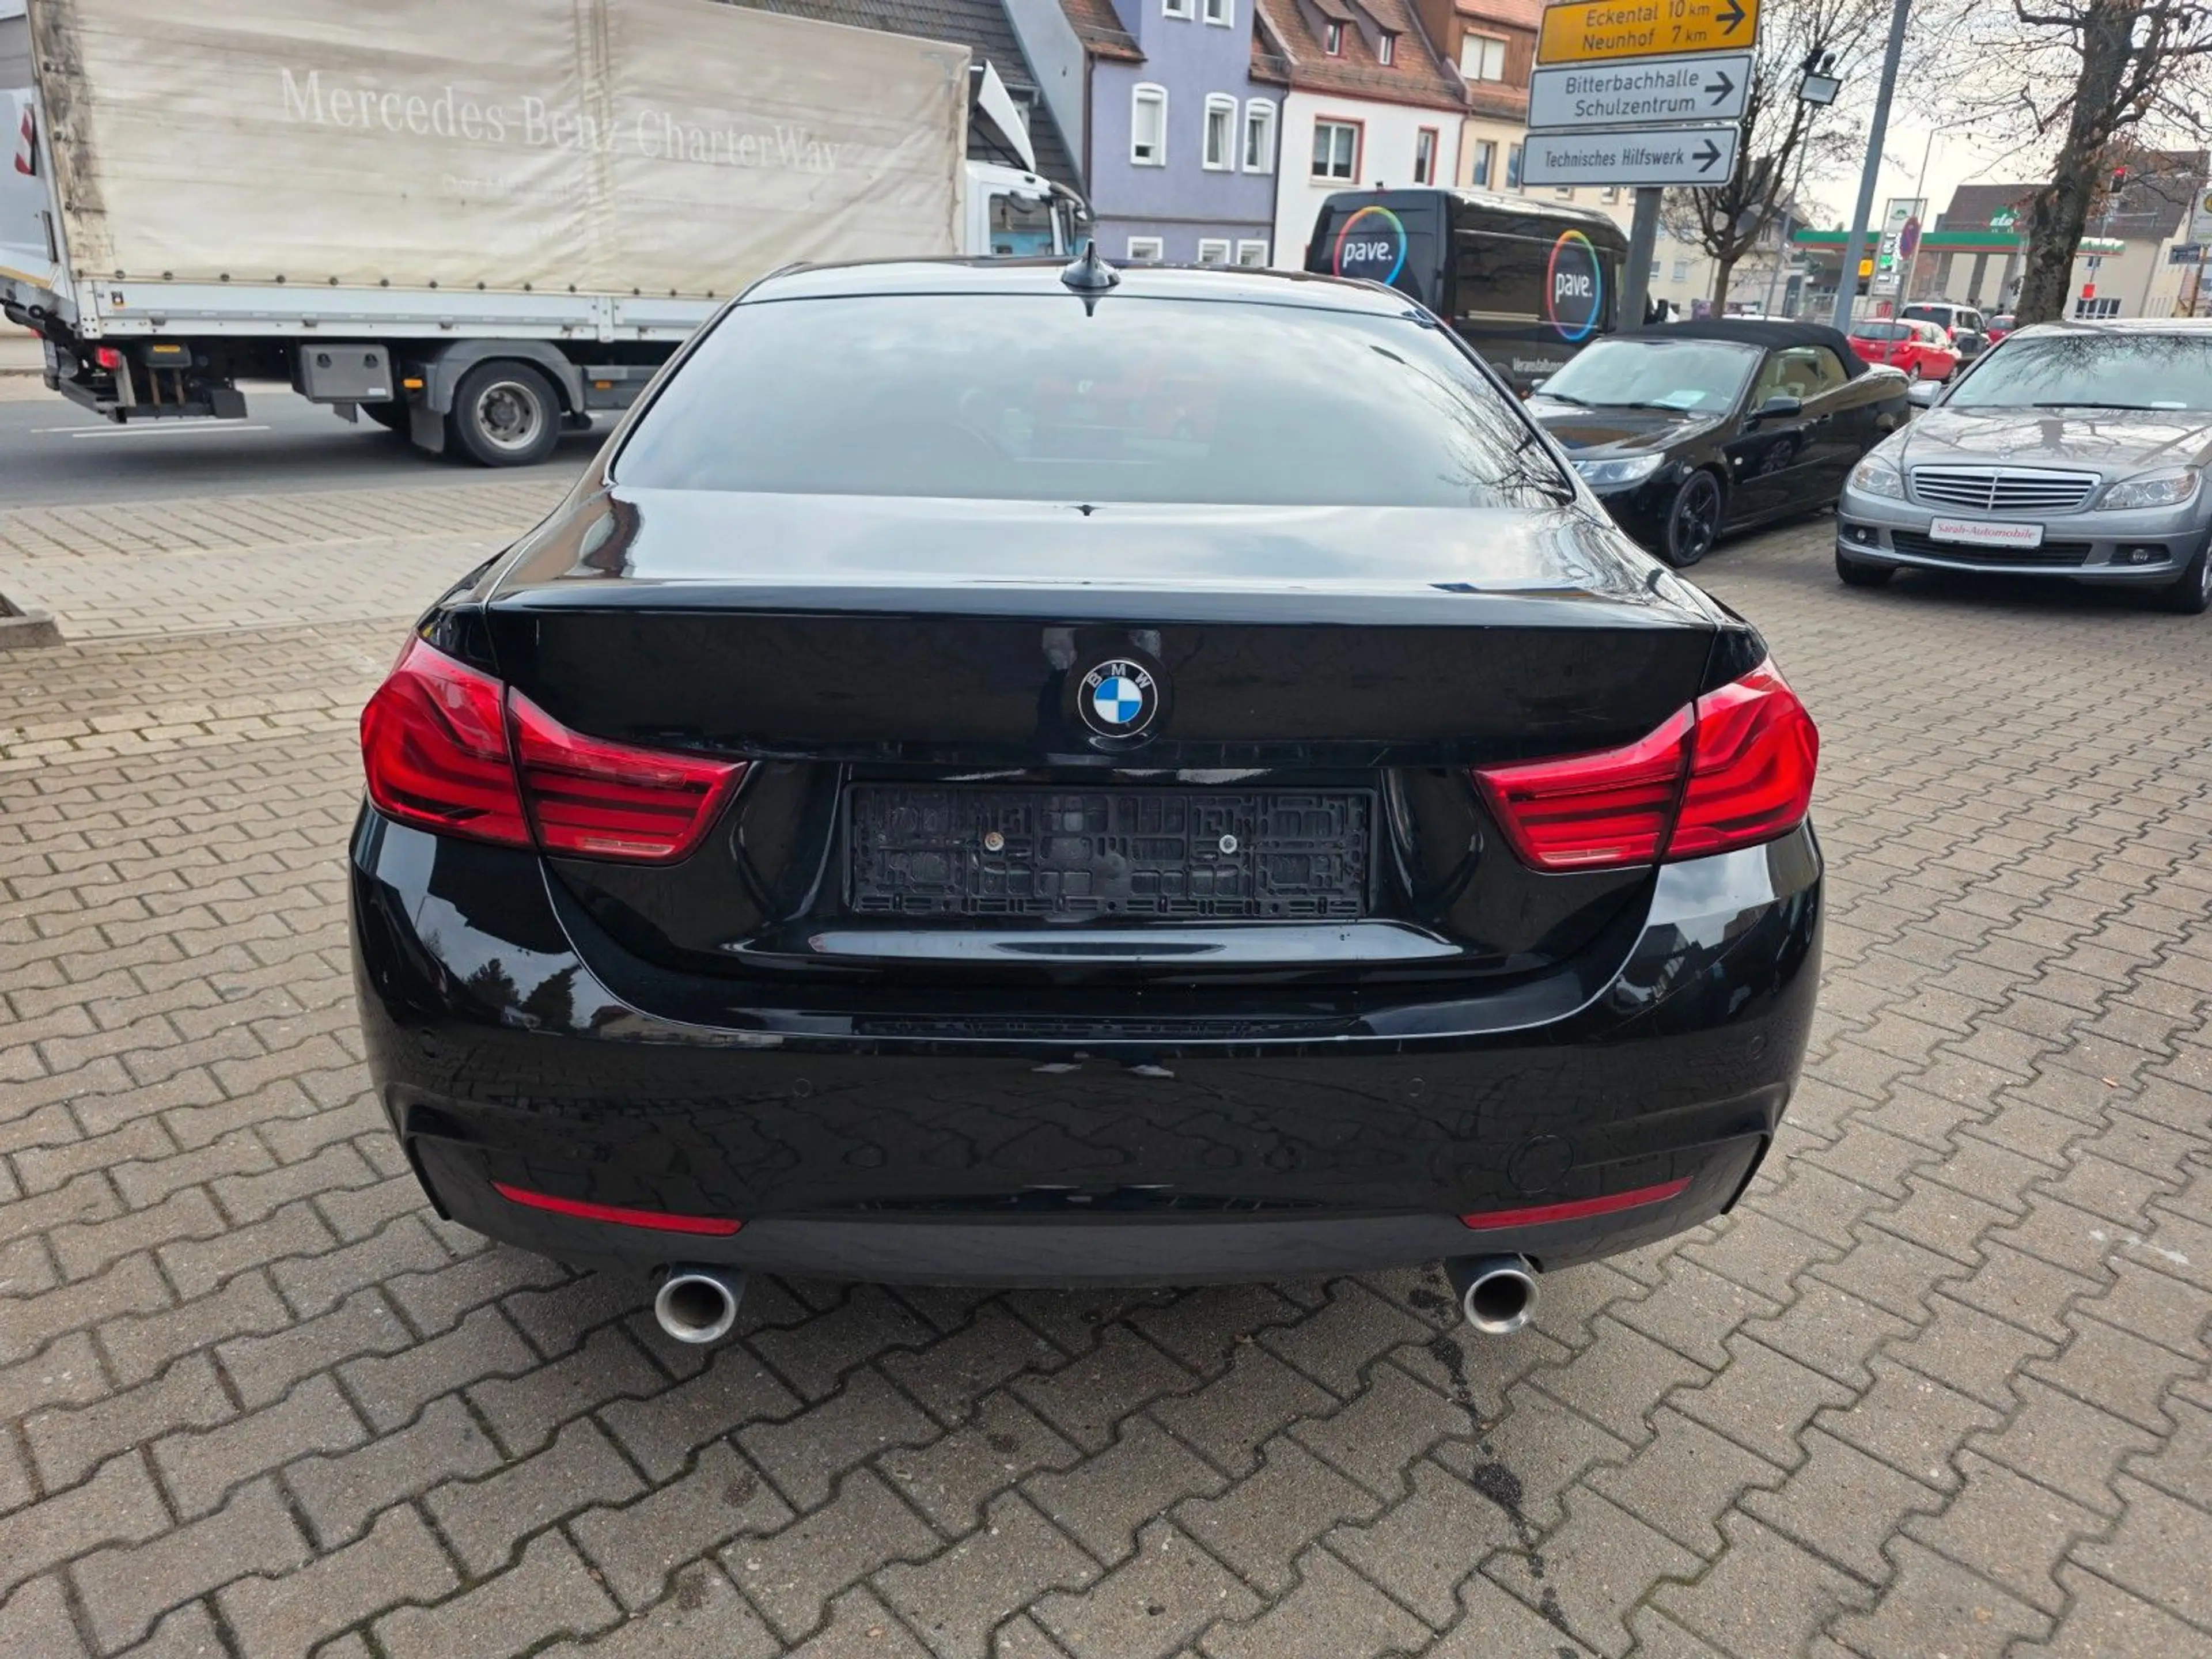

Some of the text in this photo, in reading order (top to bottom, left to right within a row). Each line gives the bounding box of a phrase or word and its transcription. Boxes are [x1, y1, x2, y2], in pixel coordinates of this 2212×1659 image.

[1586, 0, 1710, 28] Eckental 10 km
[1583, 25, 1707, 51] Neunhof 7 km
[1565, 70, 1699, 94] Bitterbachhalle
[1574, 96, 1695, 117] Schulzentrum
[281, 67, 840, 173] Mercedes-Benz CharterWay
[1546, 147, 1684, 168] Technisches Hilfswerk
[1343, 239, 1392, 267] pave.
[1555, 272, 1593, 304] pave.
[1937, 523, 2035, 539] Sarah-Automobile
[1086, 664, 1152, 689] BMW
